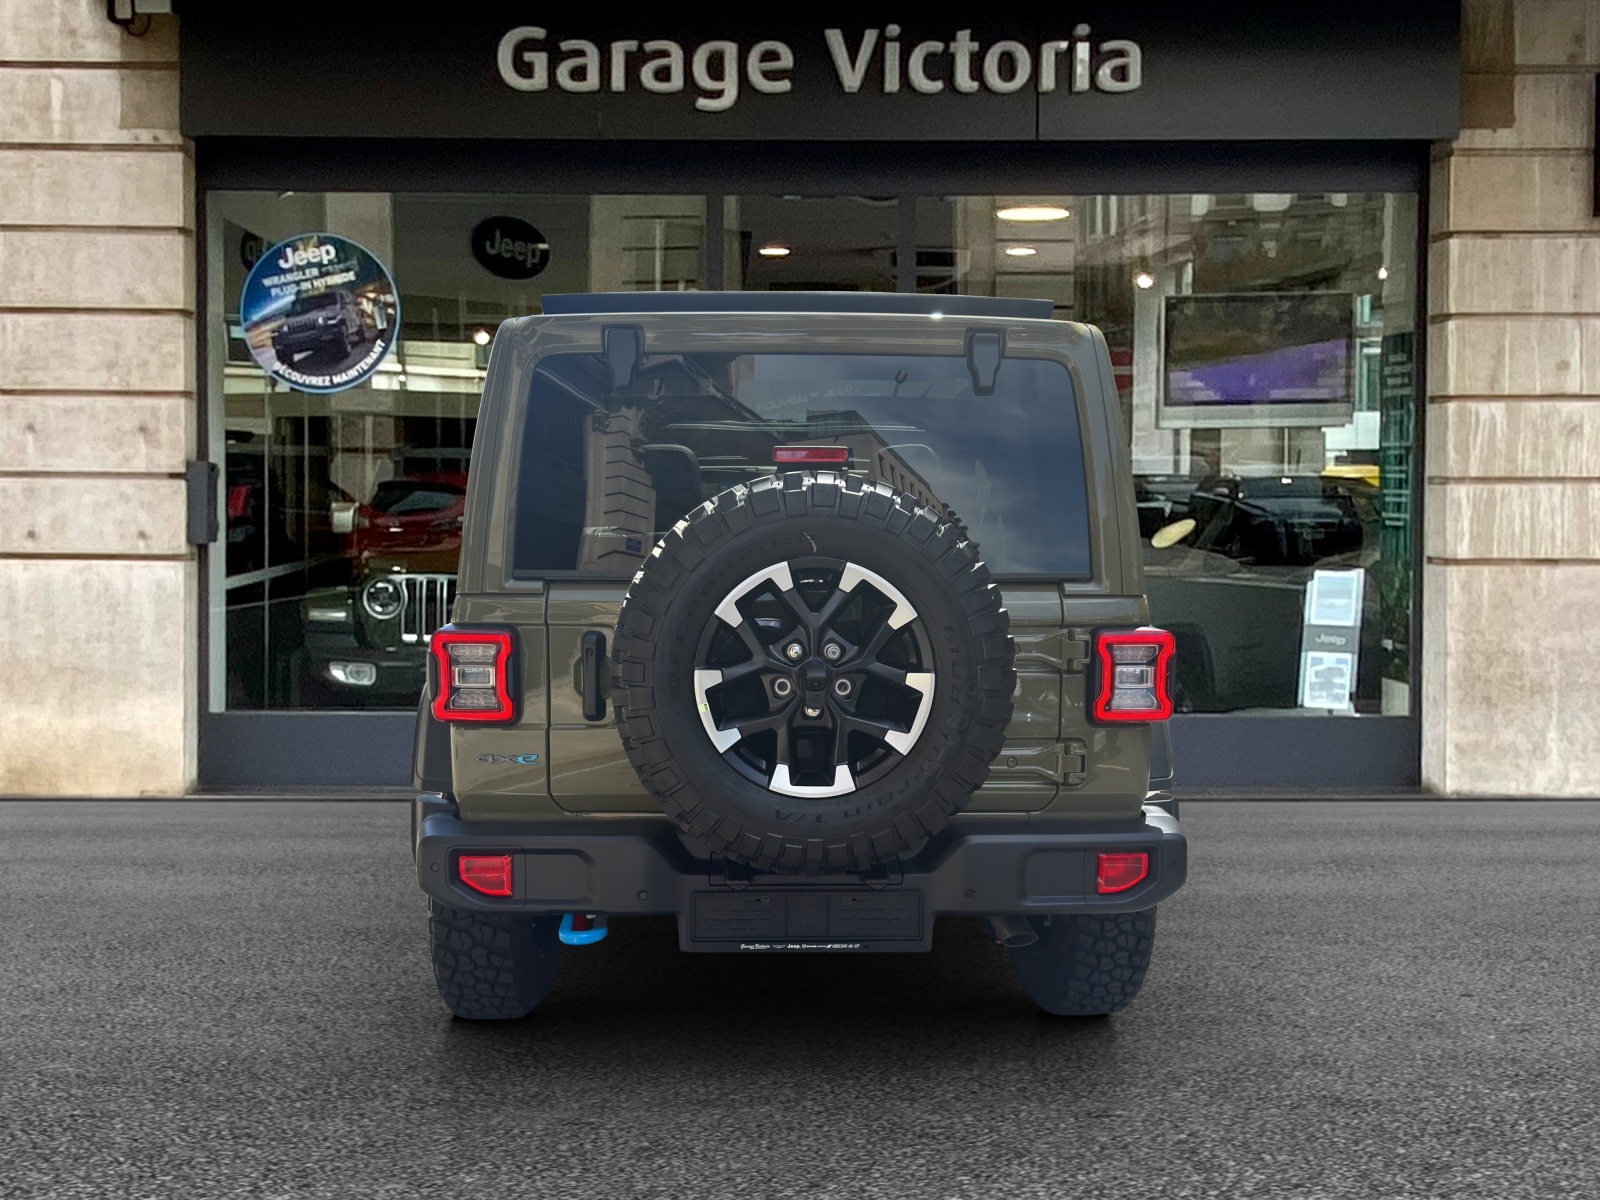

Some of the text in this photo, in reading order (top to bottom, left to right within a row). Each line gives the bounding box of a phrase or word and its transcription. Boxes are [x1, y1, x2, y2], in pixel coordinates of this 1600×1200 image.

[497, 23, 1142, 112] Garage Victoria
[278, 244, 336, 269] Jeep
[485, 229, 541, 268] Jeep
[262, 267, 319, 287] WRANGLER
[270, 271, 356, 297] PLUG-IN HYBRIDE
[332, 338, 385, 385] MAINTENANT
[1315, 633, 1346, 646] Jeep
